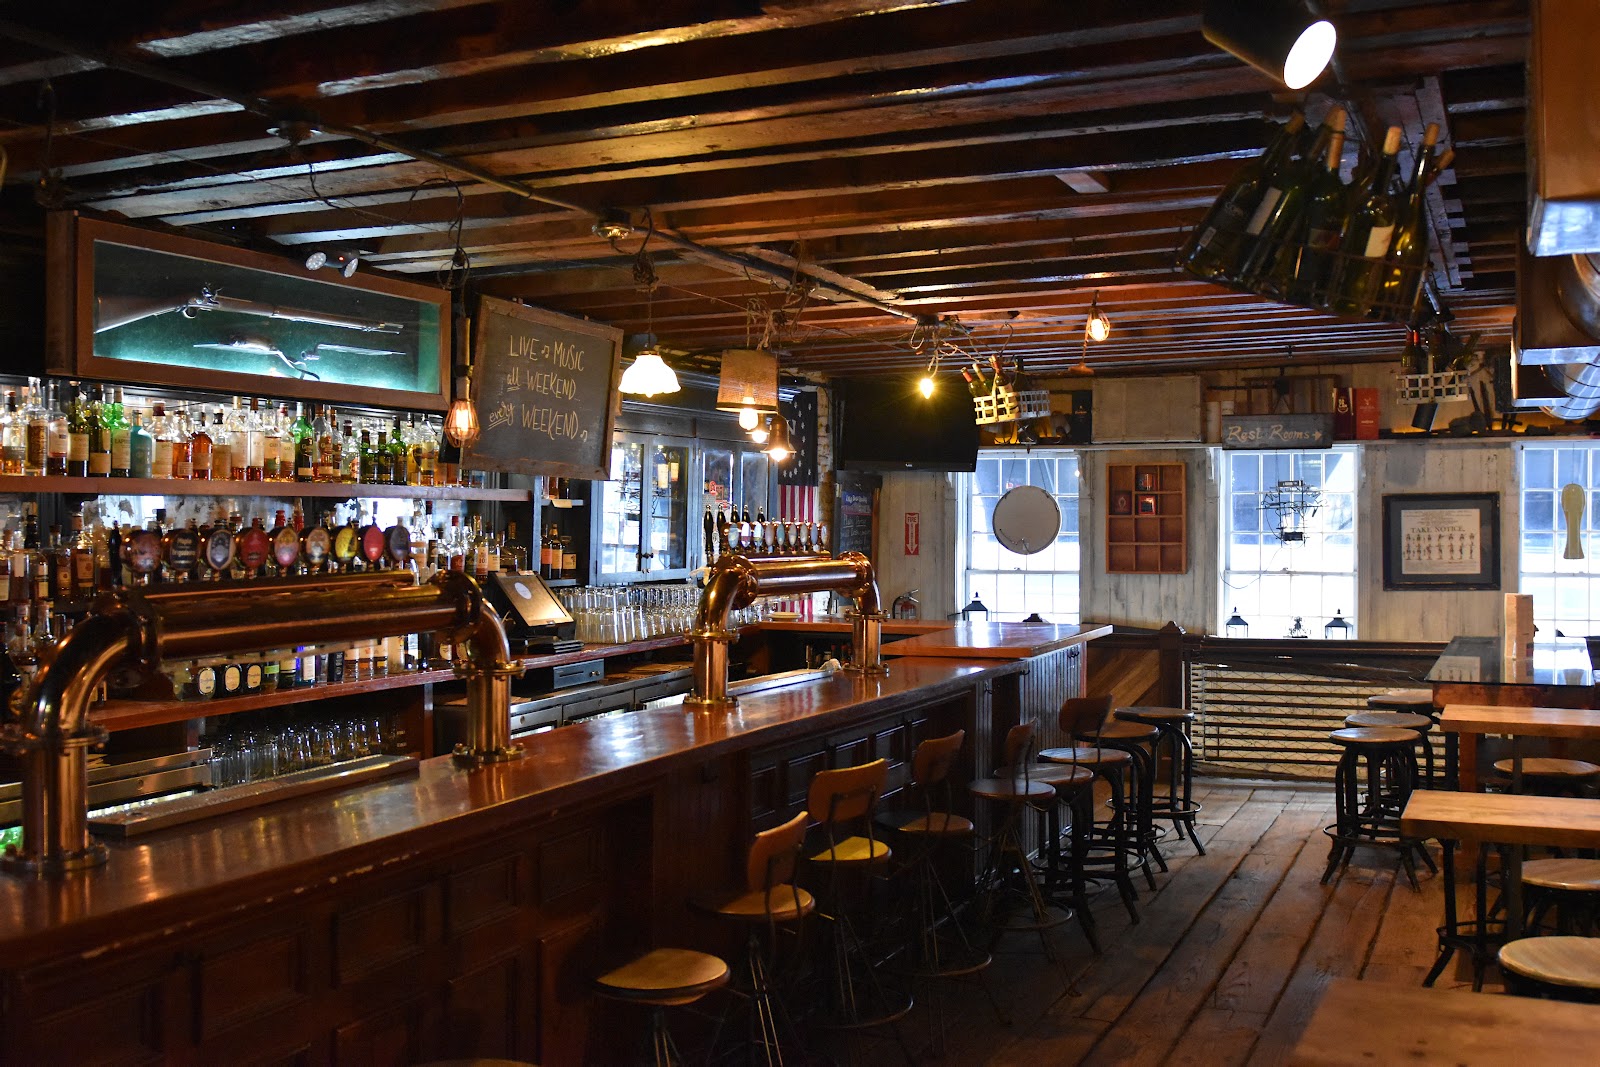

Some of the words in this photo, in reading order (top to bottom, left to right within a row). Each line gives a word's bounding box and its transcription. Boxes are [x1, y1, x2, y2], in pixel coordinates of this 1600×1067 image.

[508, 335, 540, 361] LIVE
[553, 341, 585, 372] MUSIC
[507, 367, 521, 387] all
[526, 370, 577, 400] WEEKEND
[489, 401, 515, 426] every
[522, 404, 579, 440] WEEKEND
[1226, 425, 1263, 443] Rest
[1268, 424, 1310, 442] Rooms
